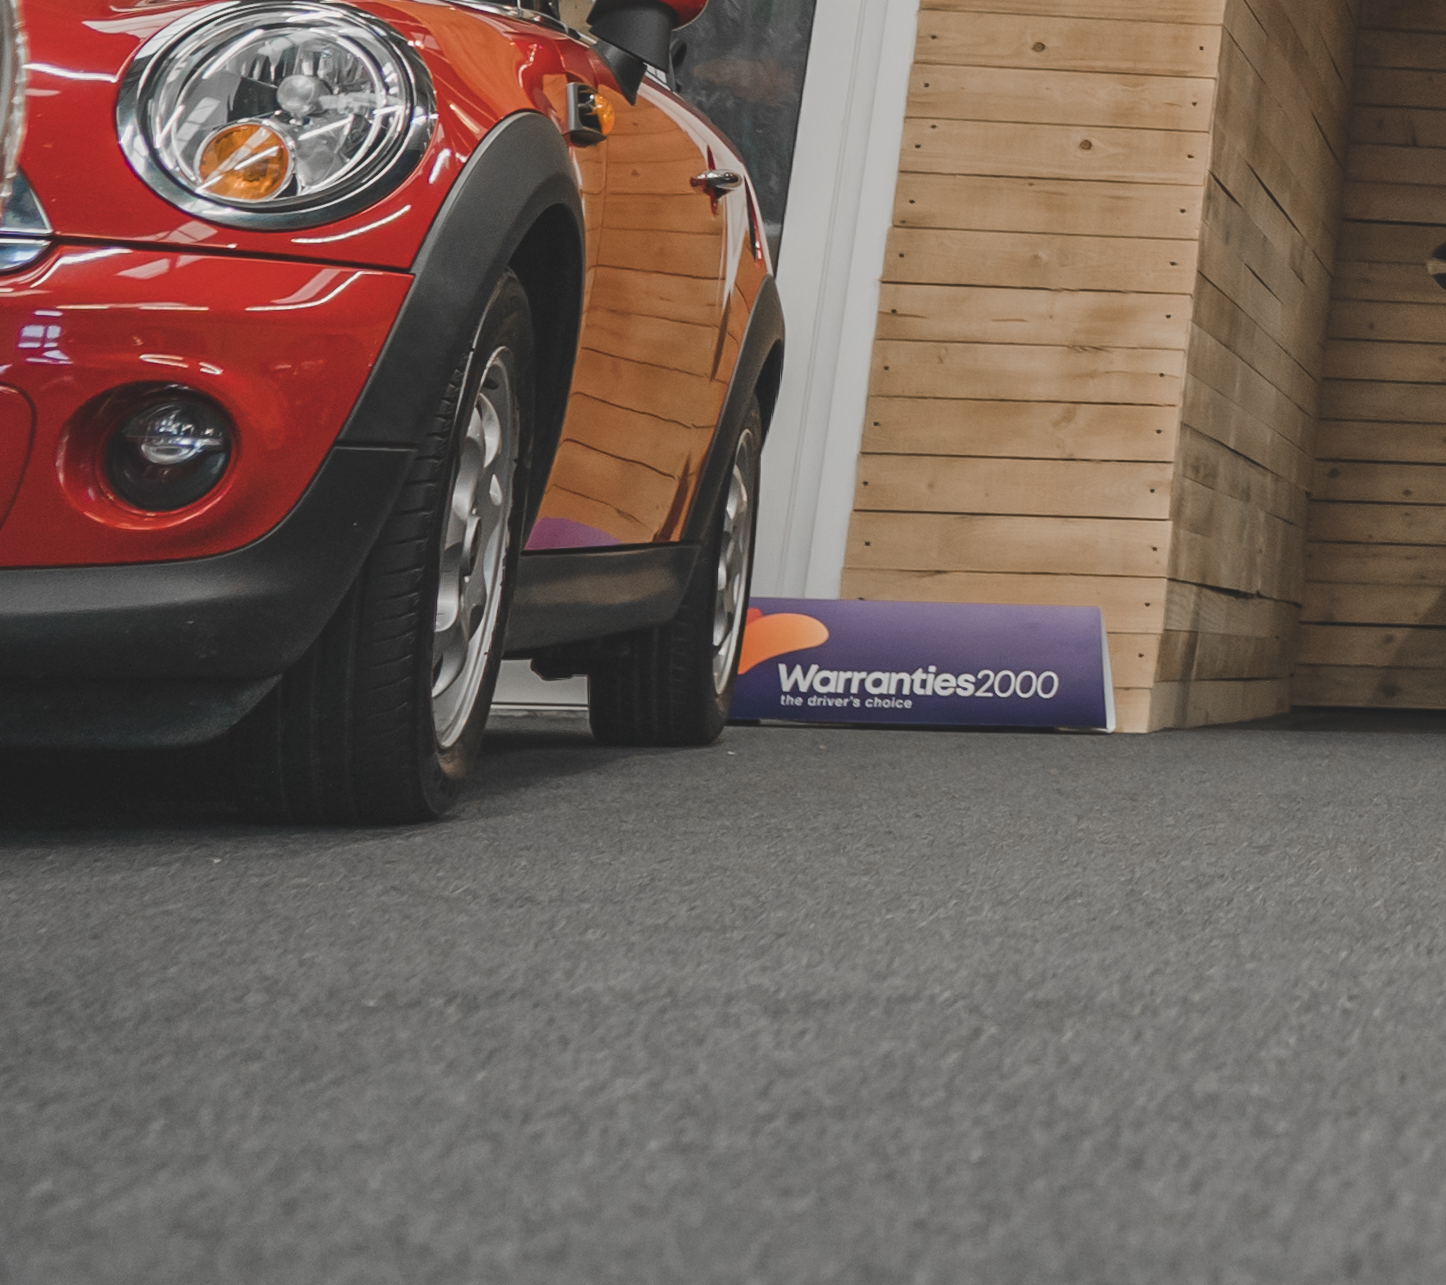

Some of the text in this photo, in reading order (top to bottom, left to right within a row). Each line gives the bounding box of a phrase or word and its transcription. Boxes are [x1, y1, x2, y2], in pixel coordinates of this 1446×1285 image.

[778, 663, 1059, 699] Warranties2000
[780, 694, 913, 709] the driver's choice
